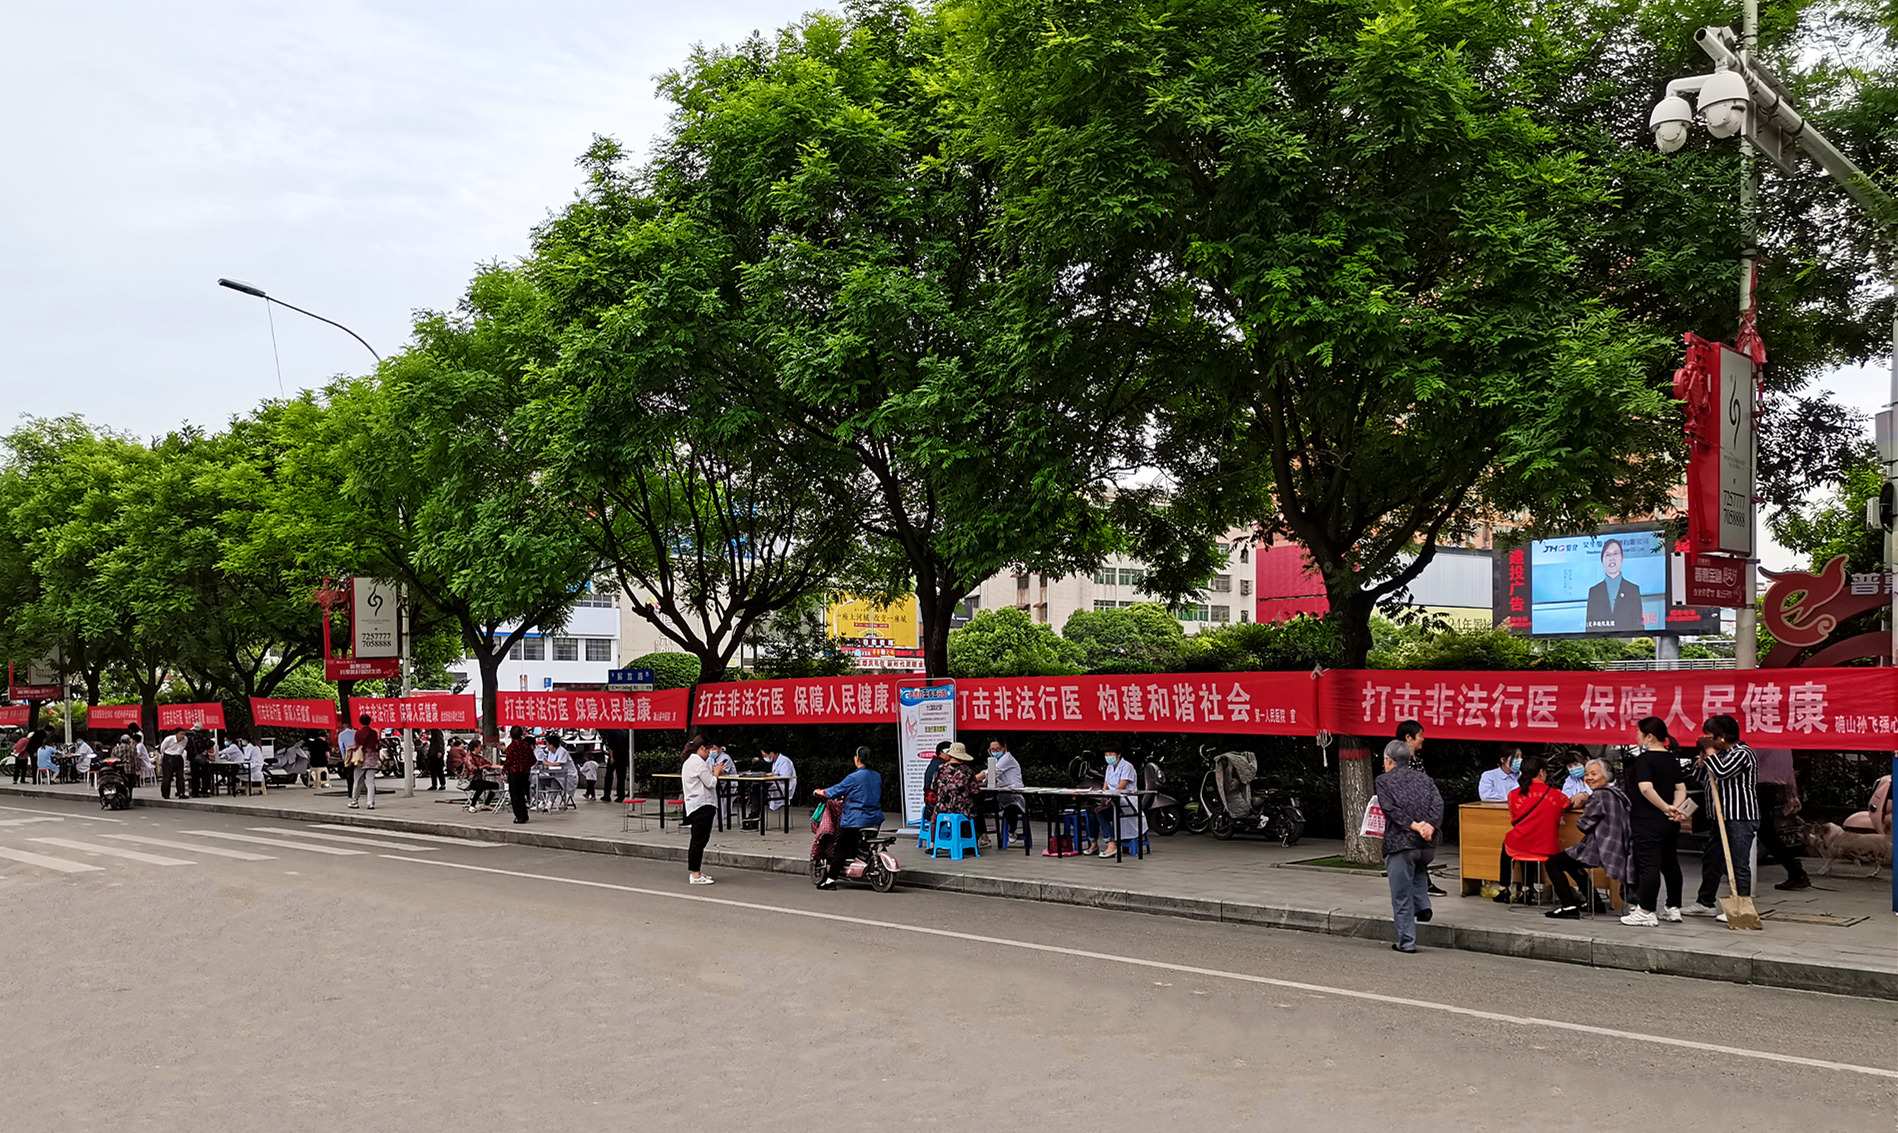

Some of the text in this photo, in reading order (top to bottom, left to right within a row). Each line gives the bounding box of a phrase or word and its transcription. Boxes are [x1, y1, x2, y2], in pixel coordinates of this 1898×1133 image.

[1509, 549, 1525, 612] 建投广告
[399, 702, 439, 723] 保障人民健康
[505, 696, 569, 721] 打击非法行医
[575, 697, 651, 722] 保障人民健康
[698, 682, 889, 718] 打击非法行医 保障人民健康
[1097, 682, 1251, 723] 构建和谐社会
[1255, 708, 1286, 723] 第一人民医院
[1362, 681, 1559, 728] 打击非法行医
[1580, 681, 1829, 734] 保障人民健康
